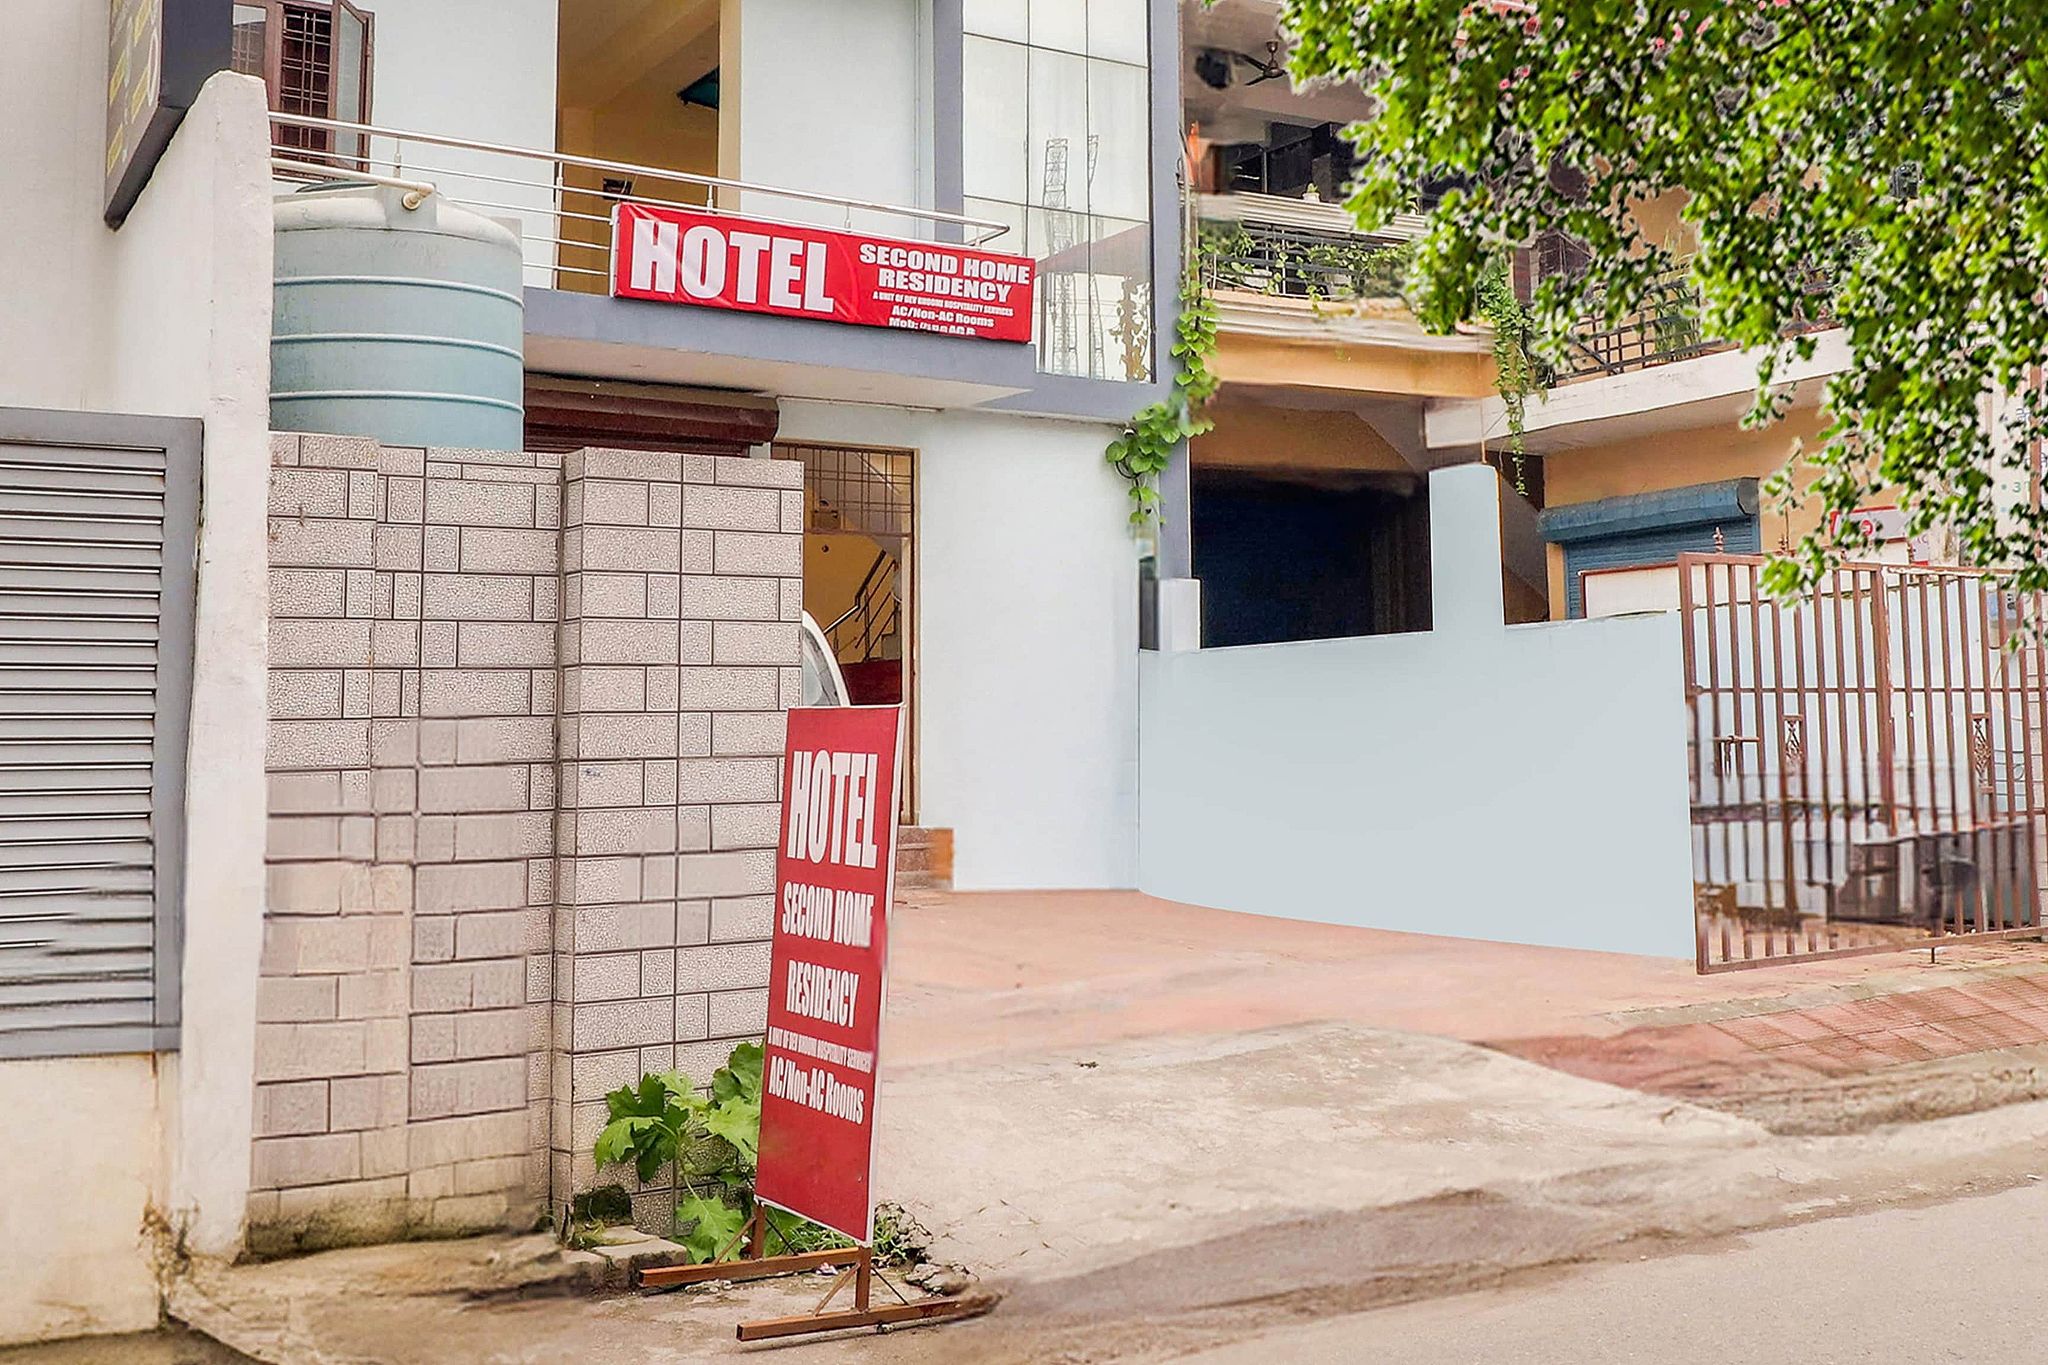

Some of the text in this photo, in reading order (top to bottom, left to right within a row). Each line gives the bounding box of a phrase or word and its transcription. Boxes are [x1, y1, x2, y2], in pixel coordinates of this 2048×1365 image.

[630, 217, 834, 313] HOTEL
[859, 243, 1031, 285] SECOND HOME
[878, 268, 1012, 303] RESIDENCY
[892, 305, 995, 328] AC/Non-AC Rooms
[787, 749, 878, 868] HOTEL
[782, 881, 874, 948] SECOND HOME
[786, 959, 860, 1028] RESIDENCY
[768, 1055, 864, 1125] AC/Non-AC Rooms
